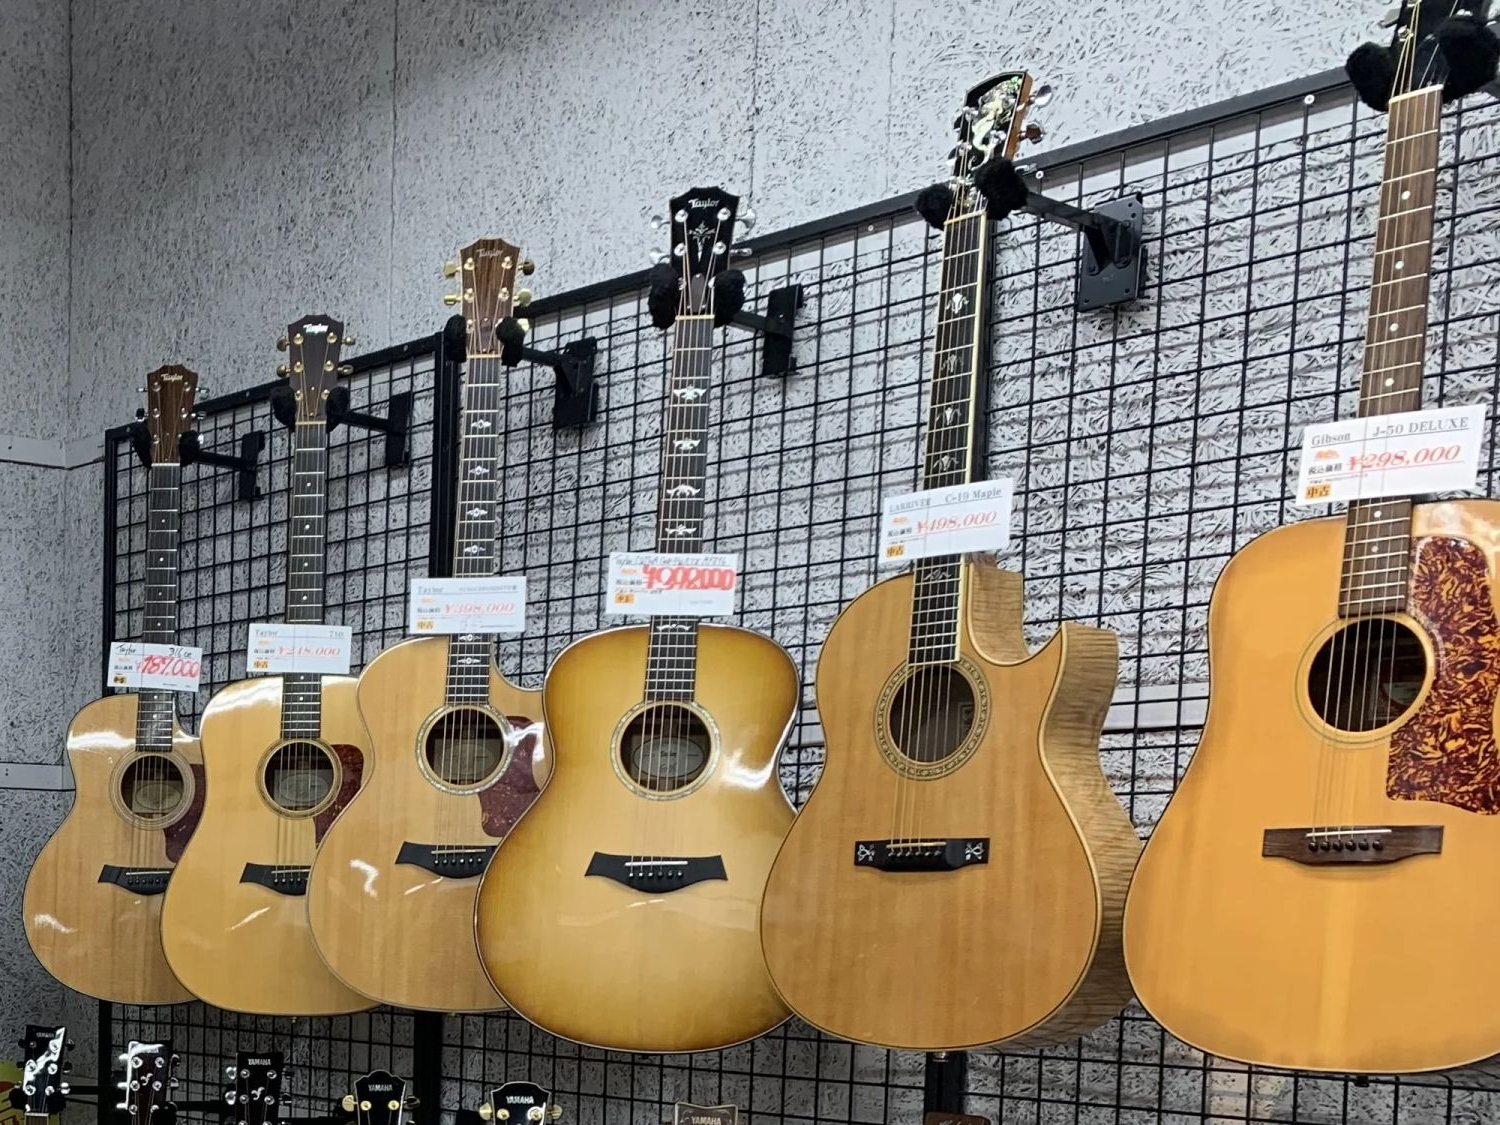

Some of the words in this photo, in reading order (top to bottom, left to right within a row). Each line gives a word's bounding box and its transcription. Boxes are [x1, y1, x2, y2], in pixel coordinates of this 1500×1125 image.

[688, 199, 720, 209] Taylor
[477, 248, 503, 258] Taylor
[303, 323, 329, 335] Taylor
[160, 374, 184, 384] Taylor
[1311, 431, 1351, 447] Gibson
[1372, 423, 1404, 438] J-50
[1409, 416, 1469, 433] DELUXE
[1308, 462, 1342, 476] 税込価格
[972, 487, 1002, 500] Maple
[1307, 485, 1331, 498] 中古
[248, 1057, 271, 1066] YAMAHA
[368, 1083, 393, 1092] YAMAHA
[506, 1095, 534, 1104] YAMAHA
[691, 1115, 722, 1125] YAMAHA
